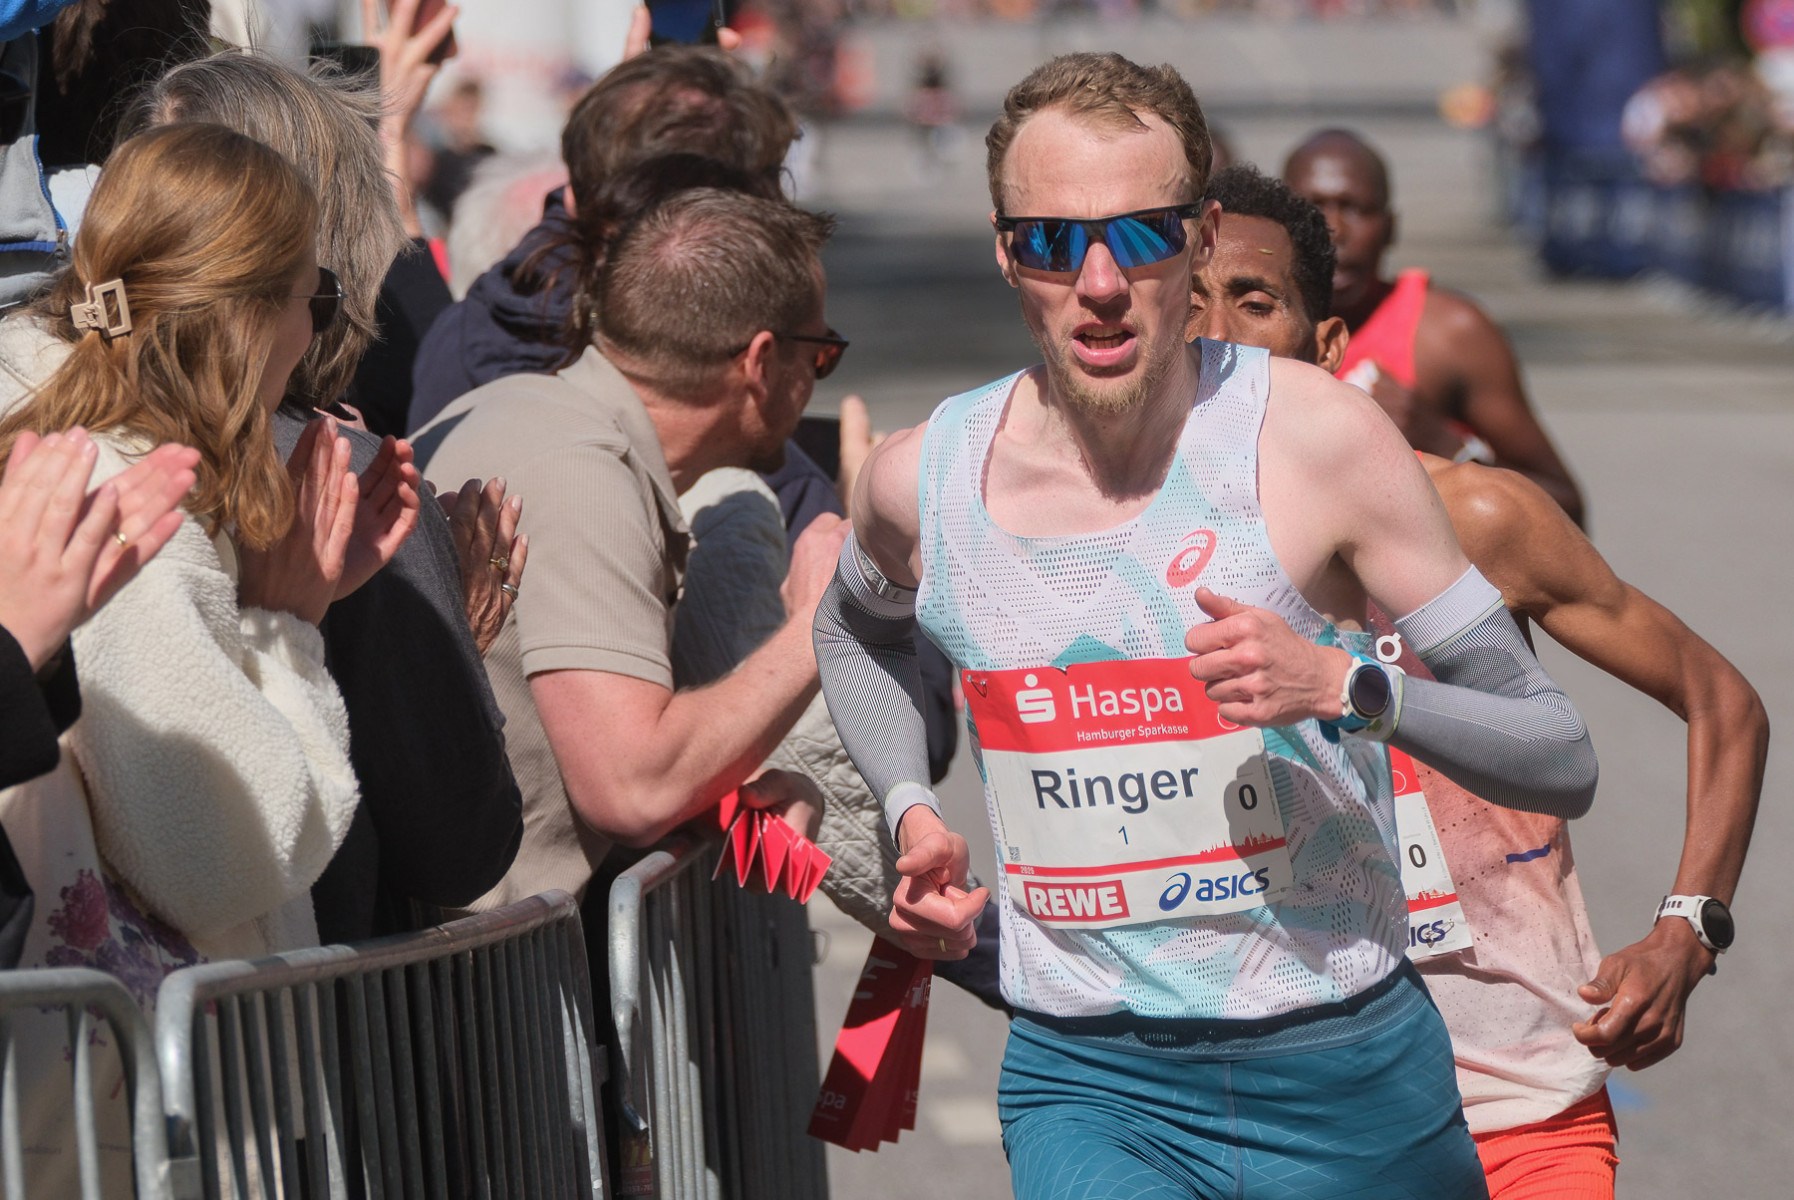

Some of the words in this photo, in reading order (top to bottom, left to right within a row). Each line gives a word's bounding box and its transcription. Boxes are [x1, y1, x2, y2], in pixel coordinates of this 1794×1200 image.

[1069, 684, 1184, 721] Haspa
[1076, 728, 1136, 742] Hamburger
[1138, 724, 1189, 739] Sparkasse
[1031, 767, 1199, 814] Ringer
[1238, 784, 1258, 810] 0
[1118, 825, 1129, 845] 1
[1408, 844, 1427, 868] 0
[1028, 886, 1123, 916] REWE
[1407, 919, 1446, 948] ICS
